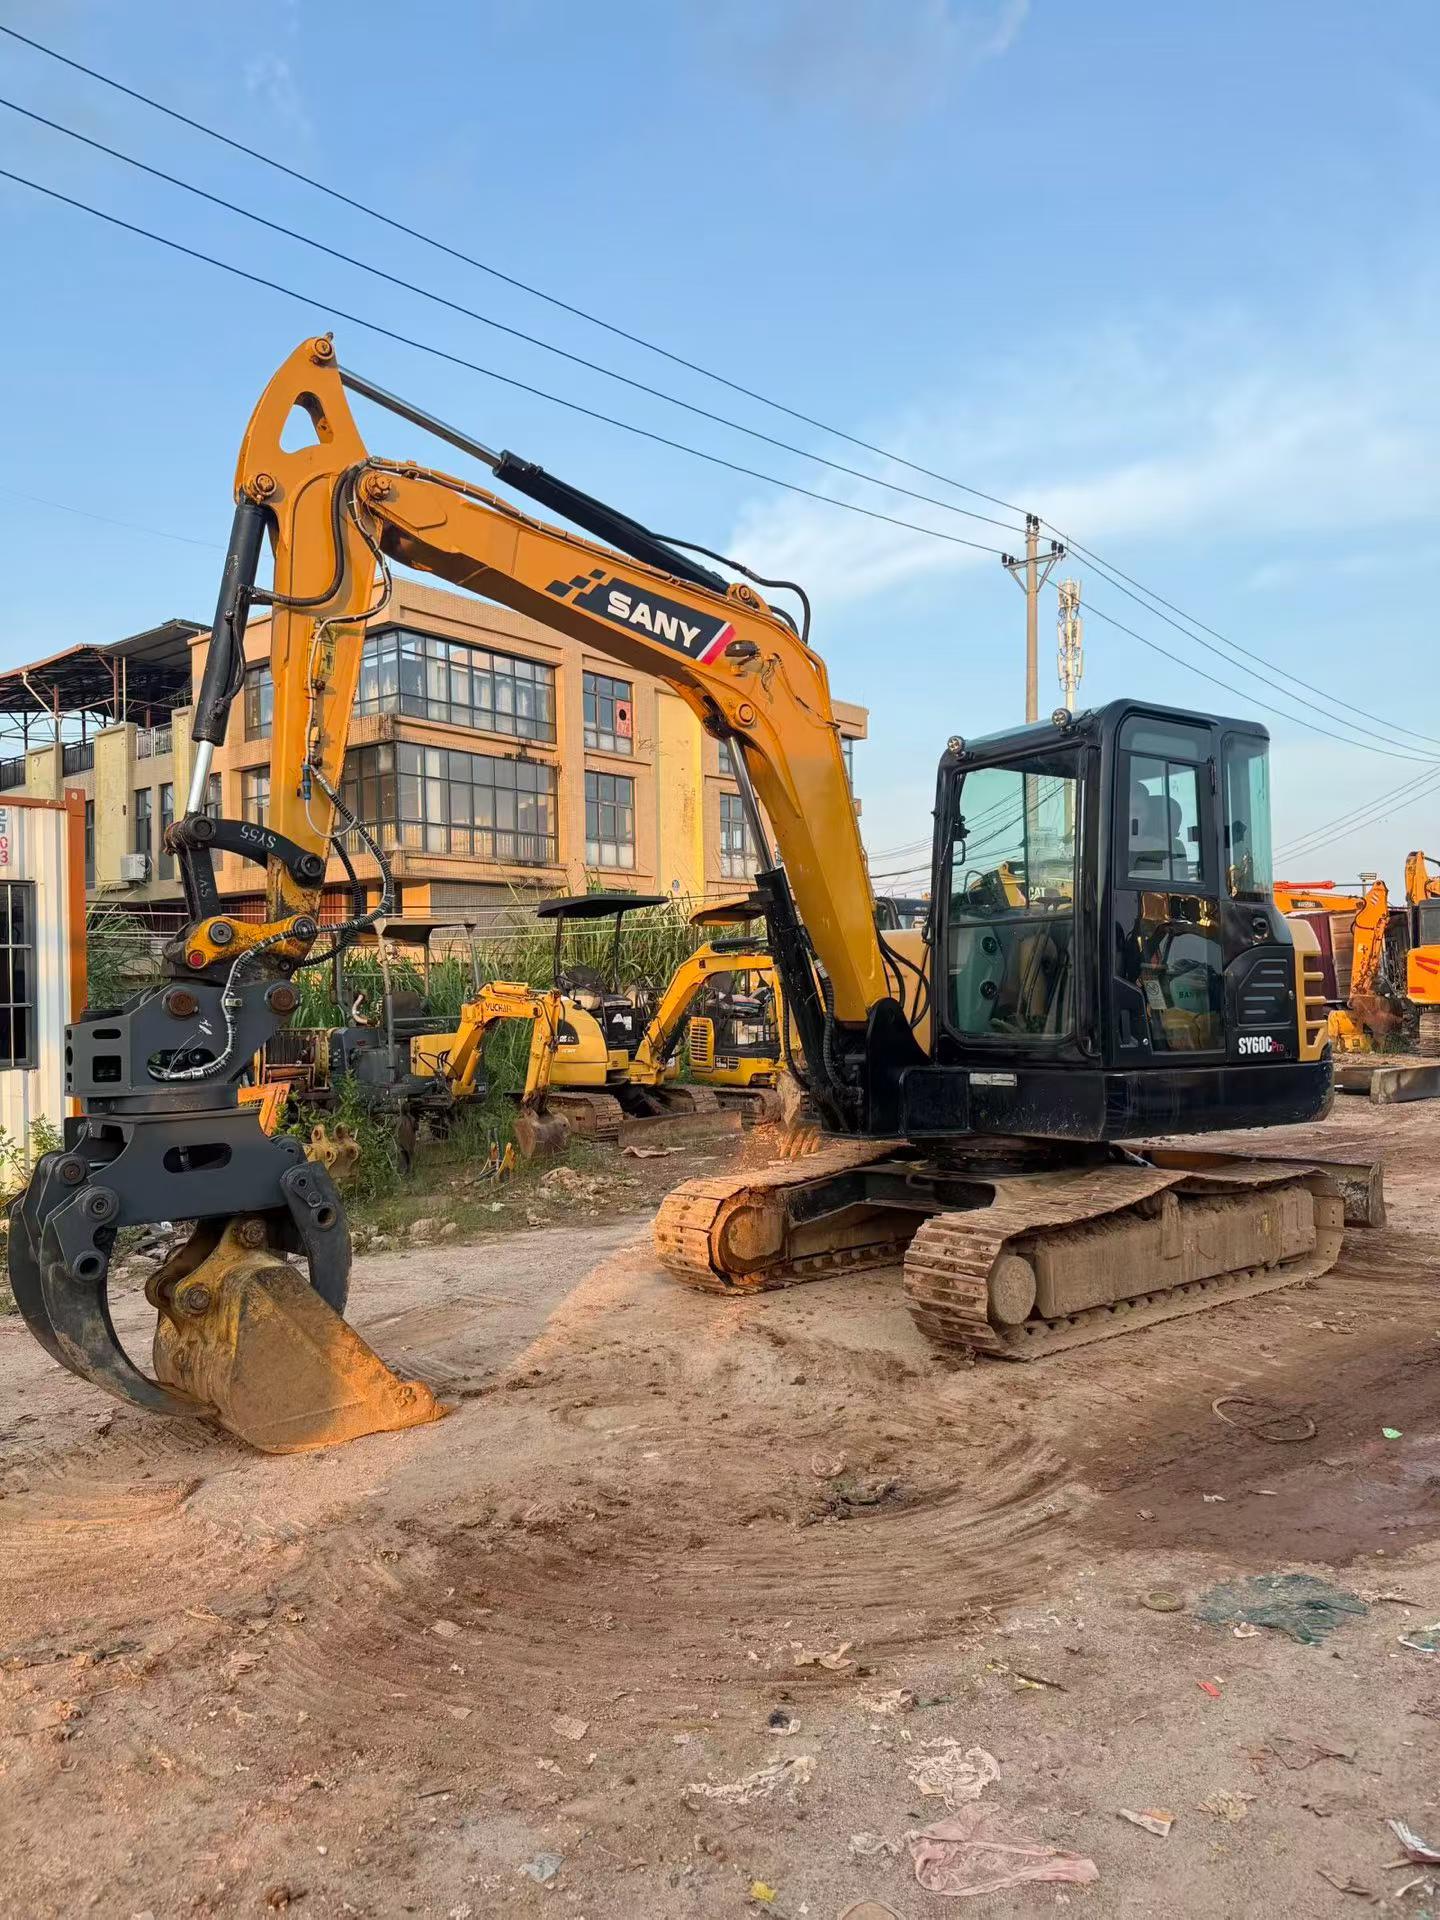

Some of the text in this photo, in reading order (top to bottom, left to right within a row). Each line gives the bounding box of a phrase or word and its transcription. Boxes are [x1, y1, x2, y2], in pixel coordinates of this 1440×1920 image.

[607, 590, 701, 649] SANY
[240, 824, 277, 849] SY55
[1238, 1036, 1272, 1055] SY60C
